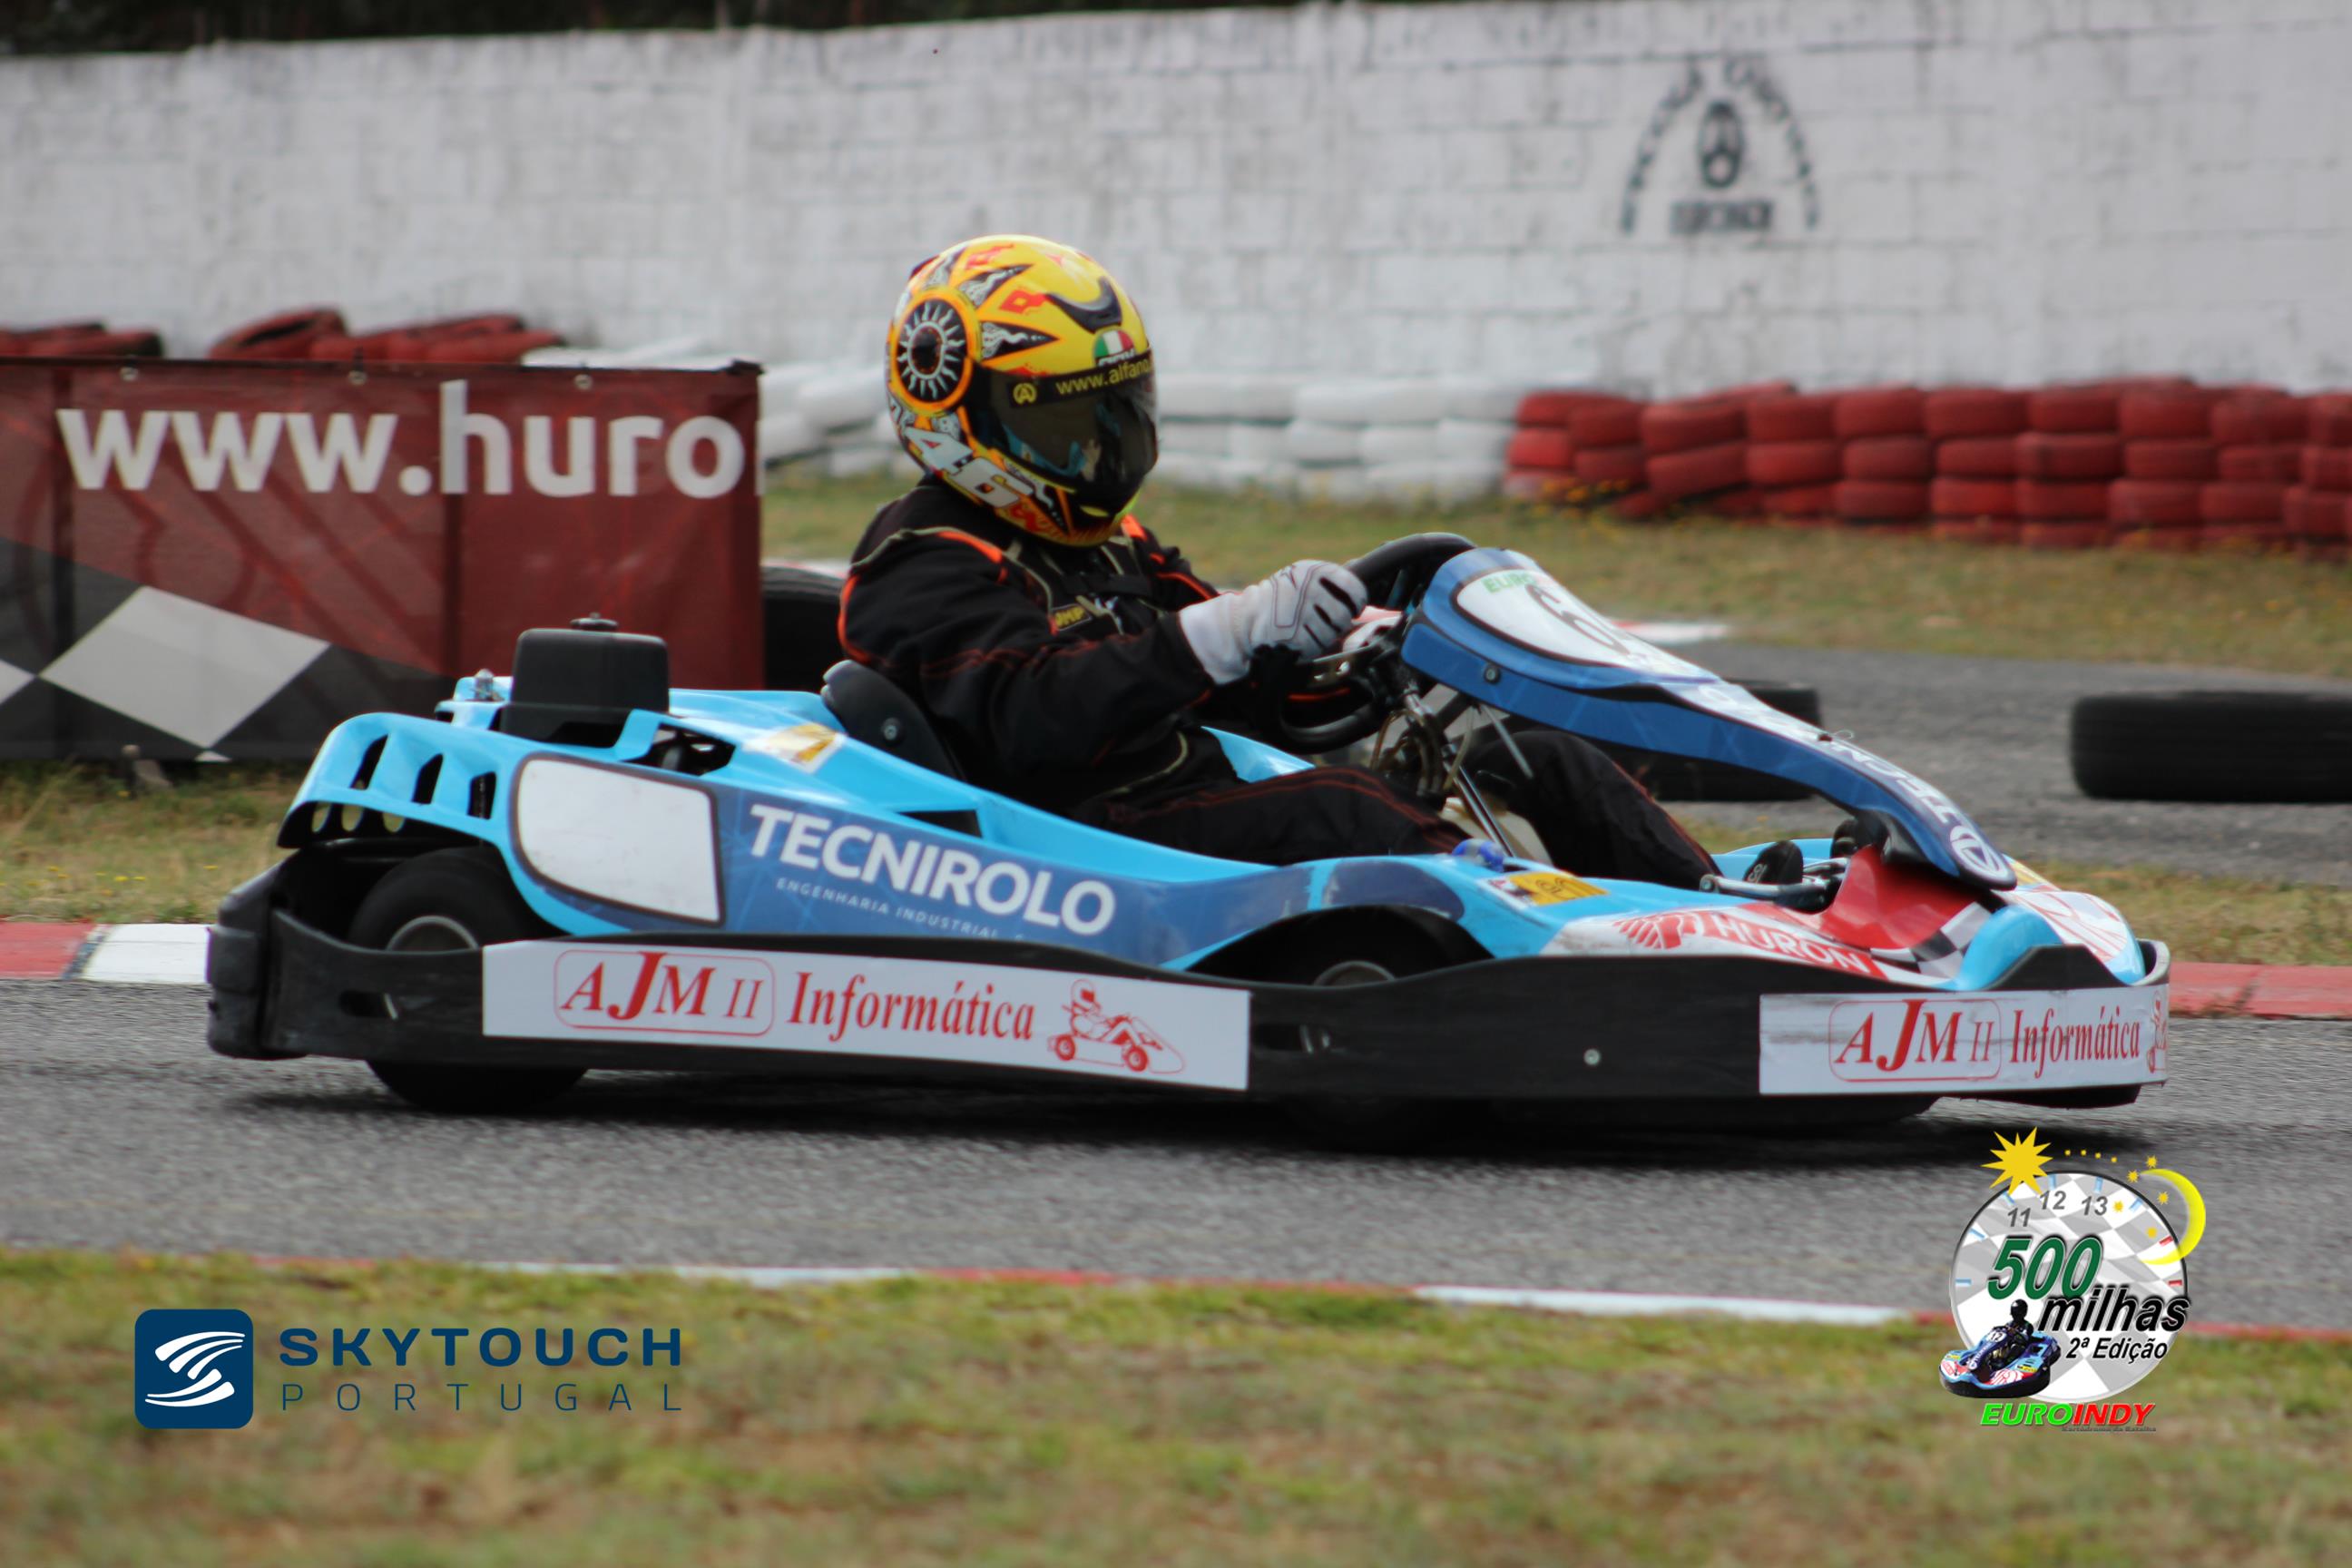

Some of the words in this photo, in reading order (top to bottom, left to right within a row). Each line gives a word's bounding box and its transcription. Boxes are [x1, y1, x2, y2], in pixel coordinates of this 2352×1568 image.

[56, 379, 763, 498] www.huro
[750, 804, 1116, 936] TECNIROLO
[776, 877, 889, 915] ENGENHARIA
[1711, 905, 1871, 974] HURON
[562, 952, 714, 1021] AJM
[788, 972, 1034, 1043] Informática
[1833, 999, 1963, 1073] AJM
[2009, 1005, 2141, 1079] Informática
